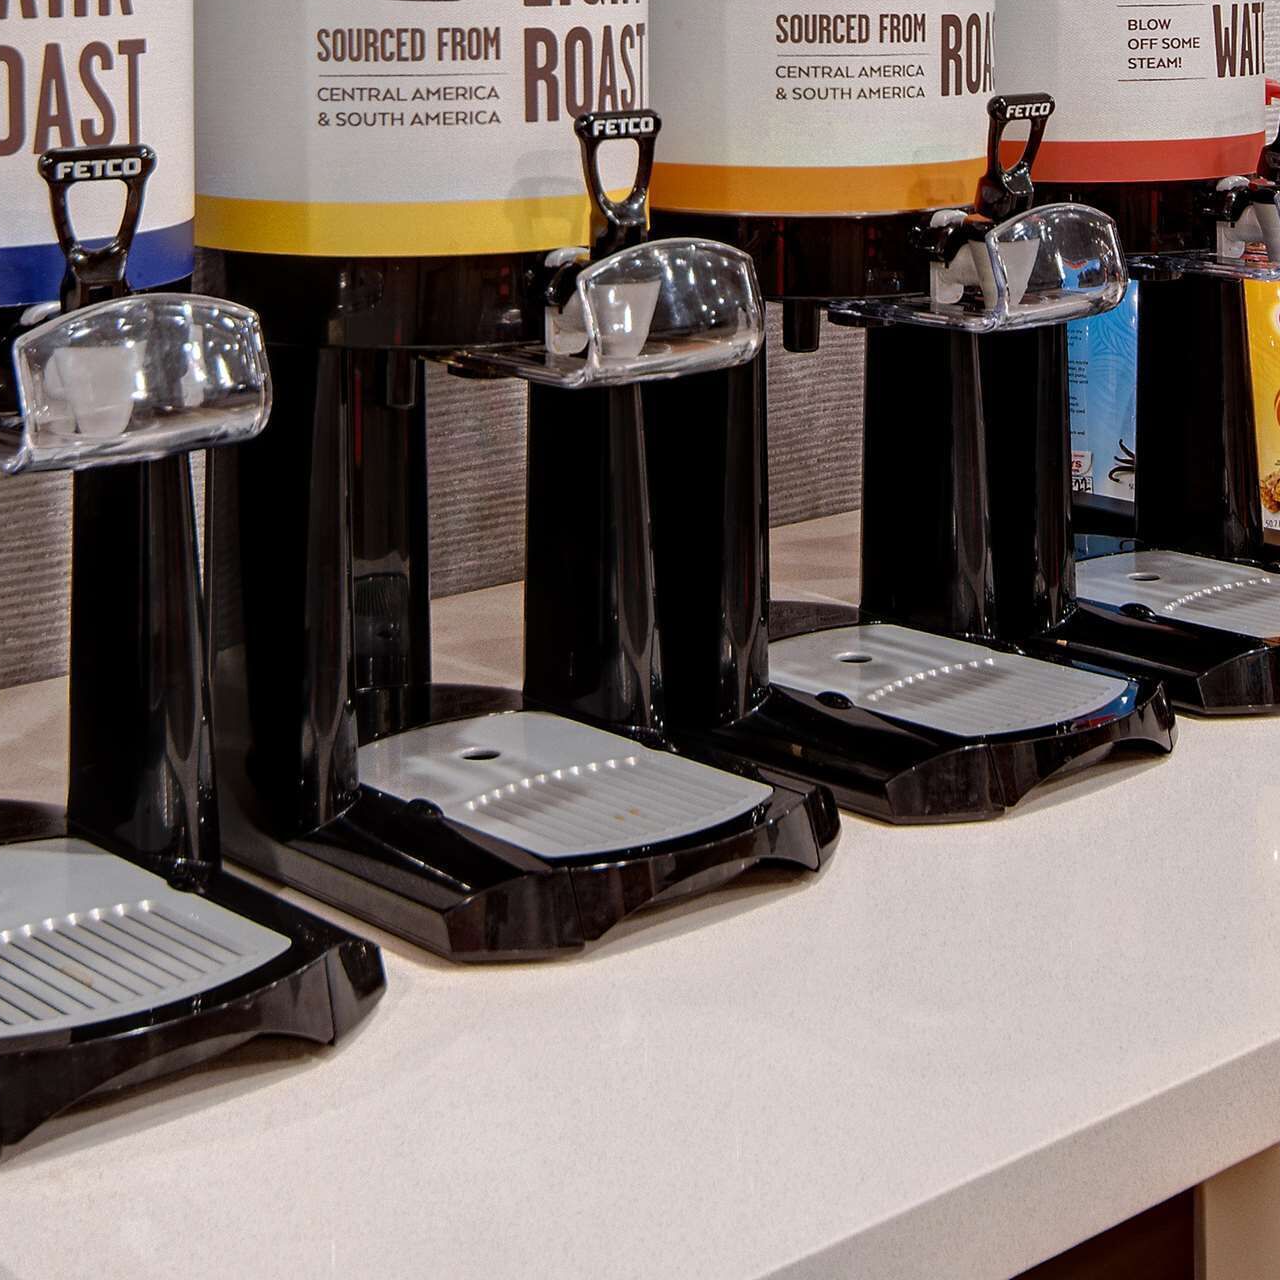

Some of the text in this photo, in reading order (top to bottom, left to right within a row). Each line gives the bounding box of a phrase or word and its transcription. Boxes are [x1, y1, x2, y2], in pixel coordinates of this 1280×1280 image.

[776, 13, 926, 44] SOURCED FROM
[1128, 19, 1171, 31] BLOW
[317, 27, 501, 62] SOURCED FROM
[1128, 37, 1200, 50] OFF SOME
[941, 13, 995, 97] ROA
[1128, 57, 1181, 69] STEAM!
[524, 22, 644, 122] ROAST
[775, 64, 924, 79] CENTRAL AMERICA
[317, 86, 500, 102] CENTRAL AMERICA
[776, 86, 925, 100] & SOUTH AMERICA
[1006, 103, 1050, 118] FETCO
[318, 111, 501, 127] & SOUTH AMERICA
[593, 117, 654, 136] FETCO
[56, 158, 141, 179] FETCO
